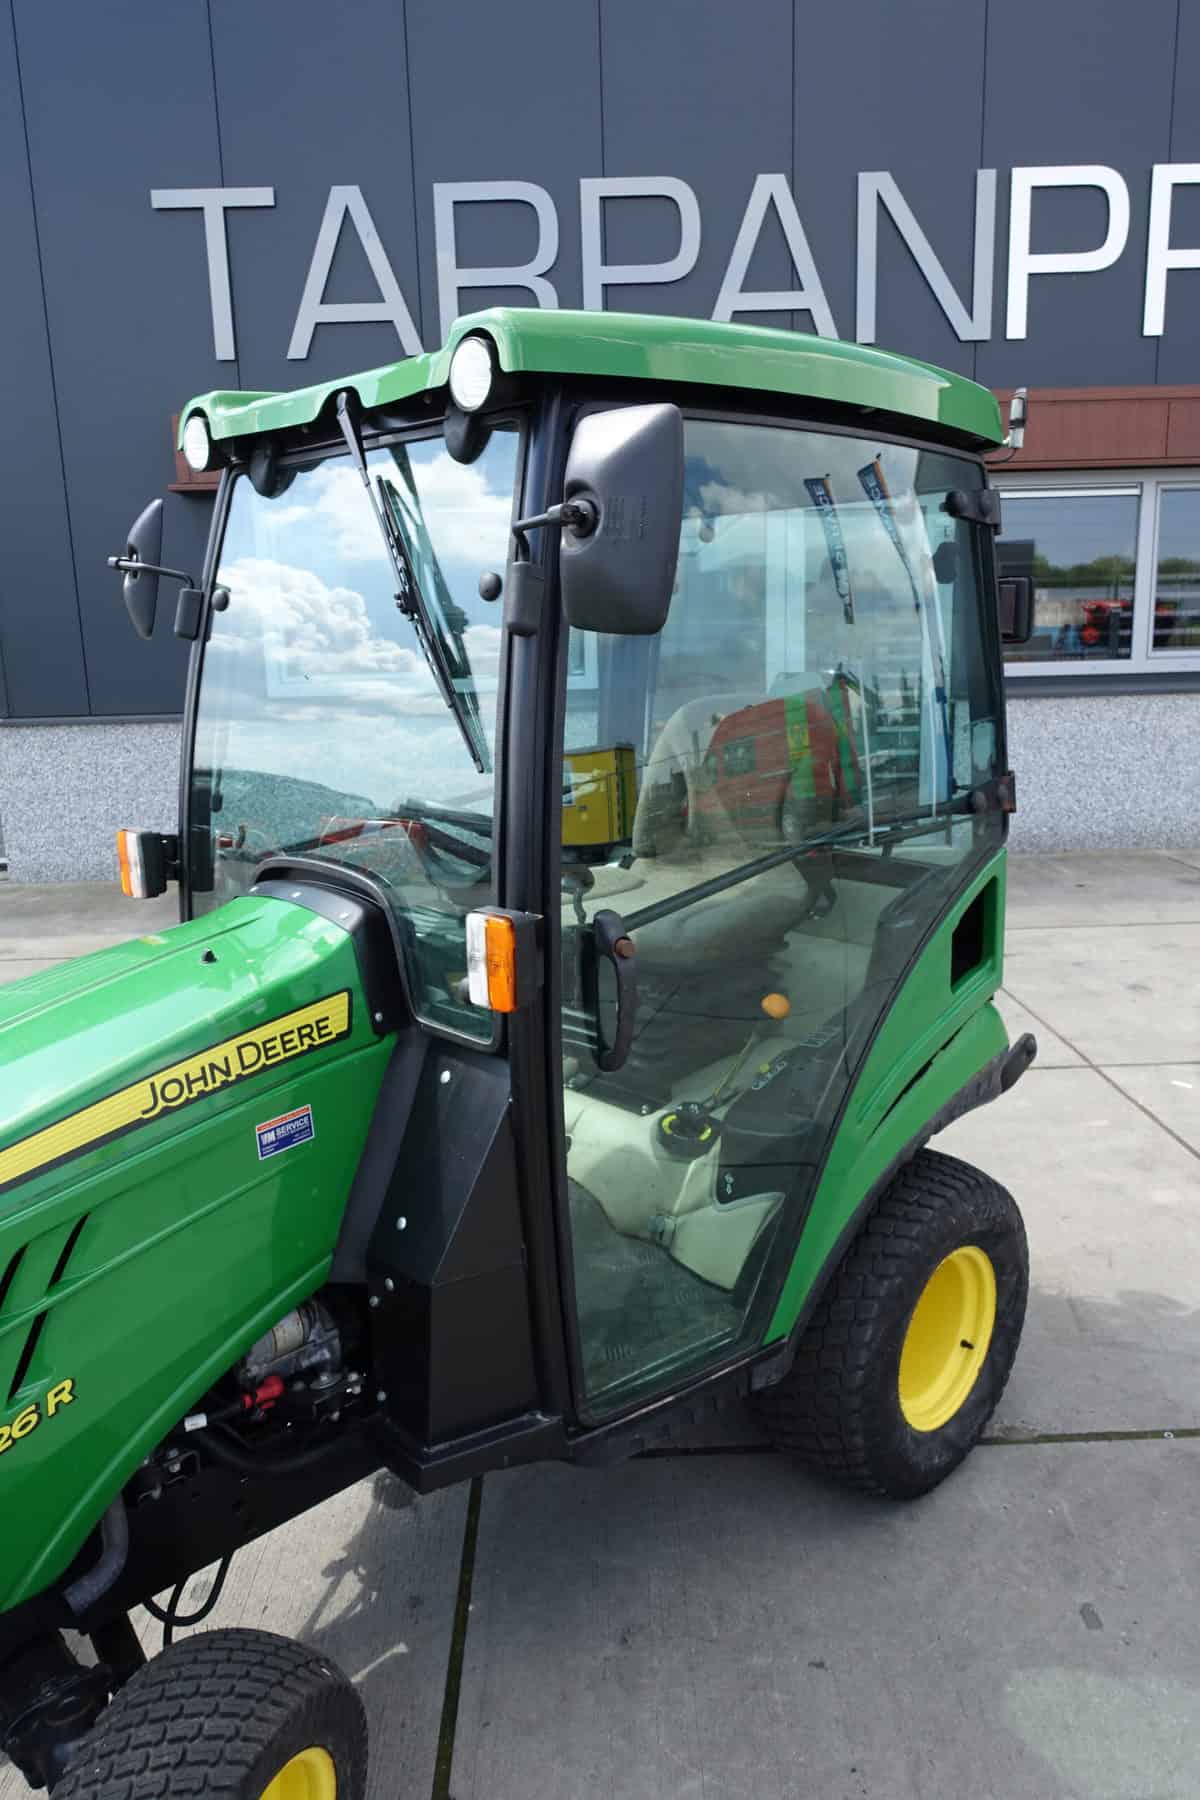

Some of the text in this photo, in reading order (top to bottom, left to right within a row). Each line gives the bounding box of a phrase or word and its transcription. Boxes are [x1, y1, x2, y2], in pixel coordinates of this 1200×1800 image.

[141, 1016, 333, 1115] JOHN DEERE
[276, 1115, 310, 1137] SERVICE
[47, 1379, 73, 1417] R
